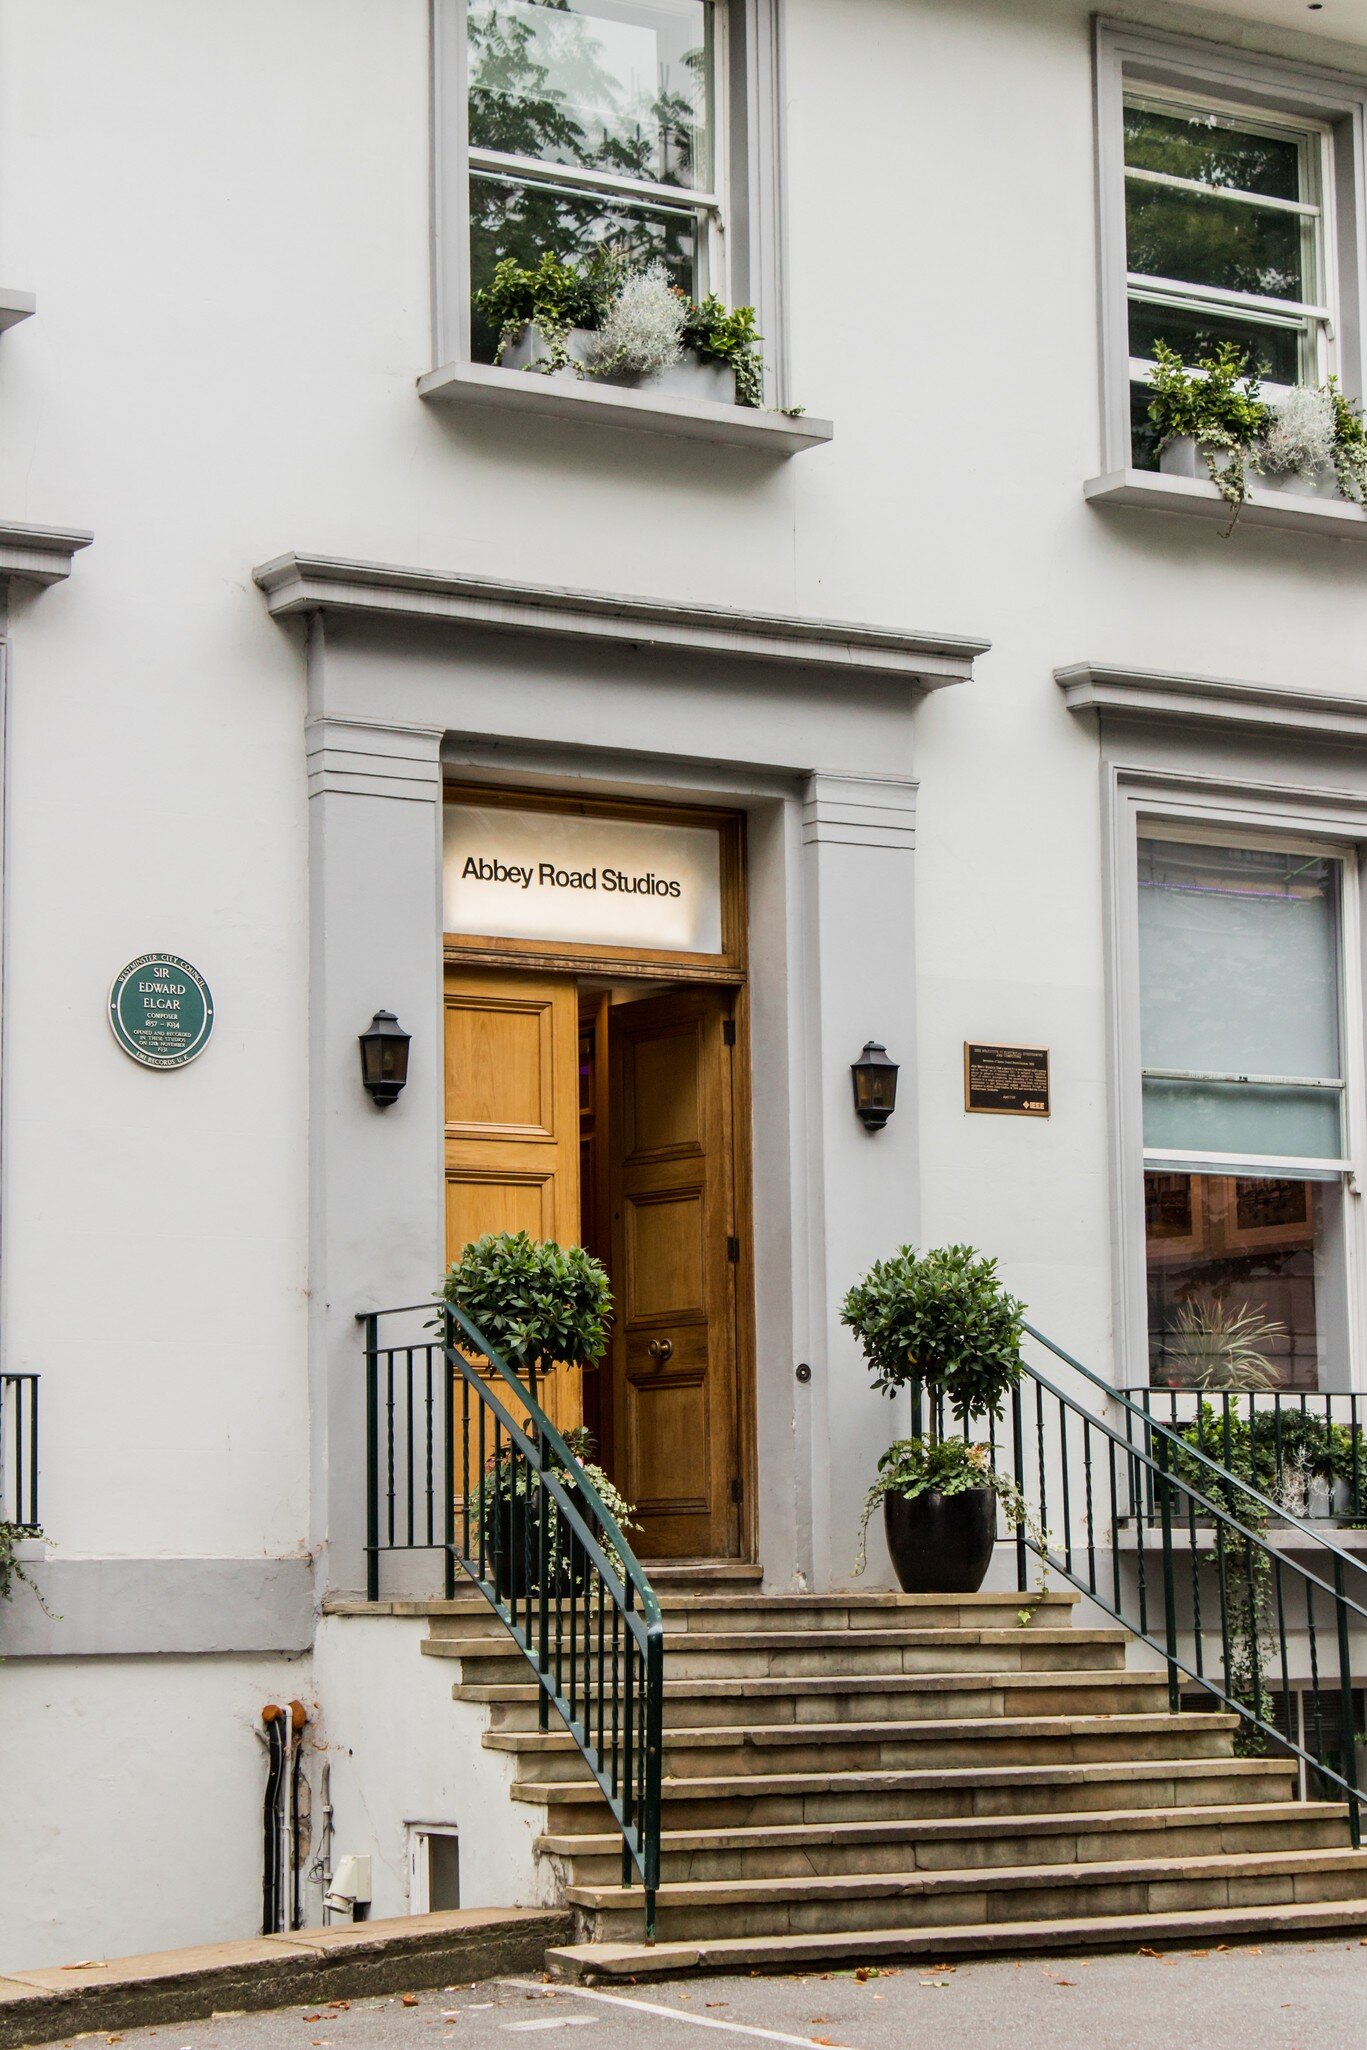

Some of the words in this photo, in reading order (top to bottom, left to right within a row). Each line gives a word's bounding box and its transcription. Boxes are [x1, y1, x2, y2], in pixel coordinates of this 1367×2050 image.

[462, 857, 534, 888] Abbey
[539, 863, 596, 889] Road
[602, 868, 681, 897] Studios
[118, 955, 157, 983] WESTMINSTER
[161, 954, 178, 963] CITY
[180, 961, 205, 987] COUNCIL
[154, 967, 170, 978] SIR
[139, 982, 185, 995] EDWARD
[143, 998, 181, 1010] ELGAR
[136, 1051, 146, 1060] EMI
[147, 1057, 175, 1066] RECORDS
[1030, 1101, 1044, 1109] IEEE
